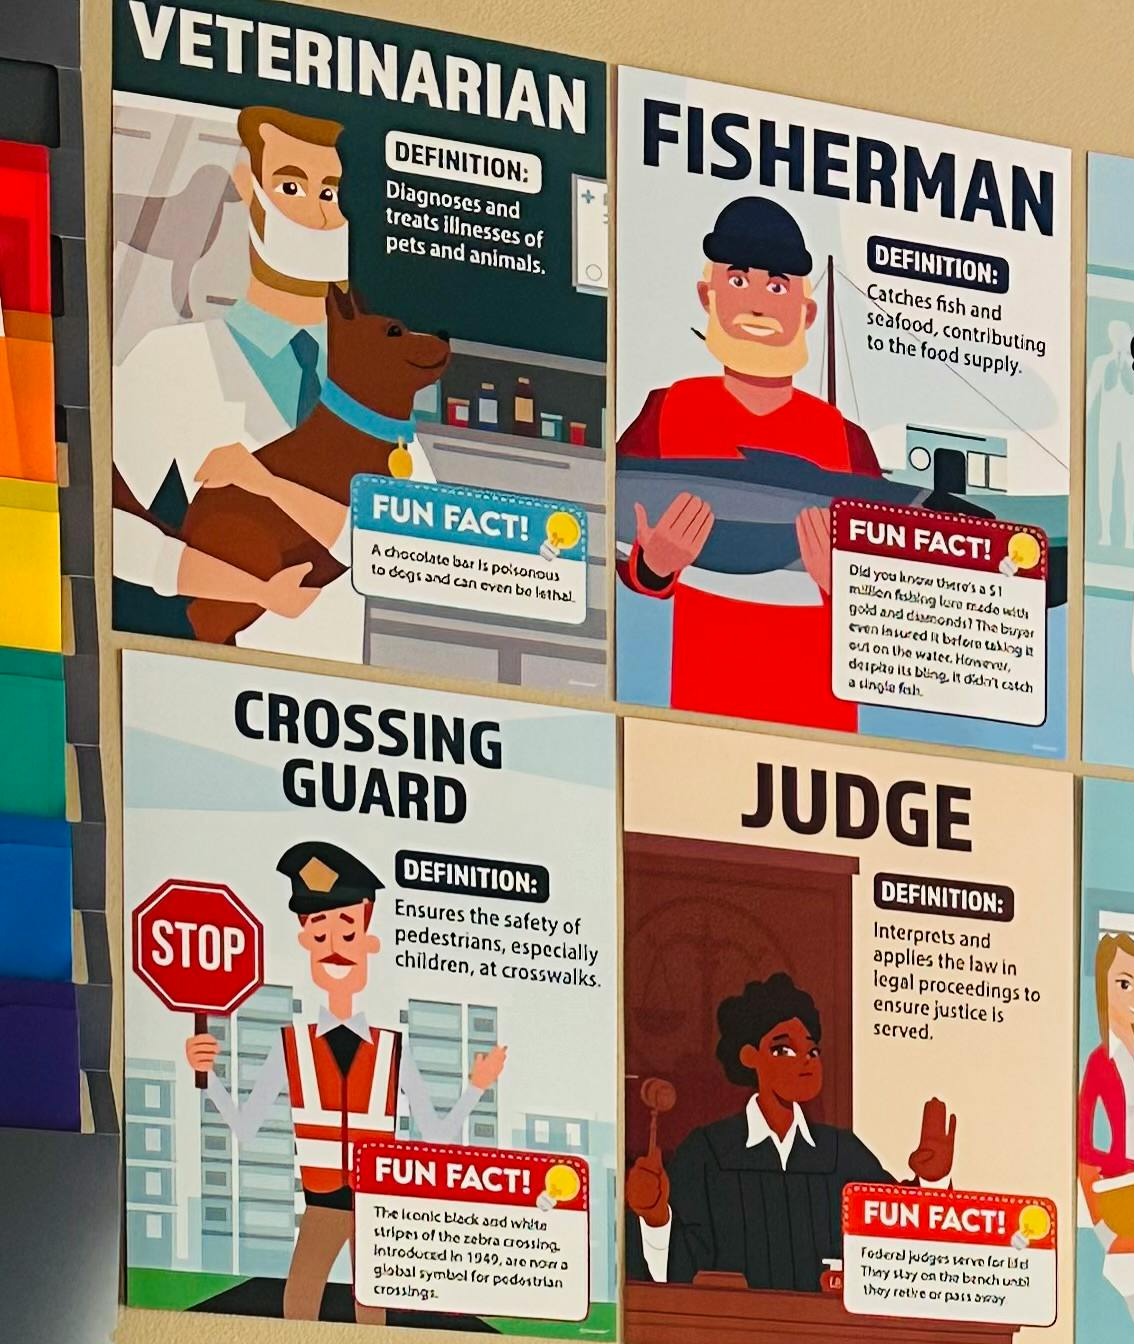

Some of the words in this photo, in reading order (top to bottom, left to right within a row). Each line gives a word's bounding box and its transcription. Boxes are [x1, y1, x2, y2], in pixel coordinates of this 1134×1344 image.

[128, 0, 585, 134] VETERINARIAN
[395, 140, 528, 183] DEFINITION:
[643, 97, 1053, 236] FISHERMAN
[386, 179, 481, 212] Diagnoses
[485, 200, 519, 219] and
[385, 207, 439, 231] treats
[443, 215, 520, 244] illnesses
[524, 229, 543, 248] of
[386, 236, 426, 254] pets
[429, 242, 464, 261] and
[469, 248, 545, 274] animals.
[875, 245, 997, 284] DEFINITION:
[867, 283, 931, 309] Catches
[936, 294, 965, 315] fish
[970, 304, 1001, 321] and
[867, 334, 883, 350] to
[888, 336, 916, 356] the
[920, 341, 958, 366] food
[964, 353, 1021, 376] supply.
[373, 493, 433, 527] FUN
[444, 503, 528, 541] FACT!
[371, 543, 381, 556] A
[384, 545, 449, 566] chocolate
[452, 554, 474, 568] bar
[849, 518, 905, 548] FUN
[914, 528, 990, 560] FACT!
[234, 690, 502, 769] CROSSING
[282, 758, 466, 824] GUARD
[741, 761, 972, 852] JUDGE
[403, 858, 537, 893] DEFINITION:
[881, 880, 1003, 914] DEFINITION:
[395, 898, 464, 922] Ensures
[469, 906, 499, 926] the
[504, 911, 558, 936] safety
[563, 917, 581, 935] of
[151, 919, 245, 972] STOP
[395, 926, 505, 954] pedestrians,
[511, 940, 598, 966] especially
[873, 947, 933, 968] applies
[938, 952, 964, 970] the
[969, 954, 998, 973] law
[1002, 959, 1016, 976] in
[395, 950, 474, 976] children,
[479, 961, 497, 977] at
[501, 965, 600, 987] crosswalks.
[874, 969, 913, 992] legal
[919, 979, 1019, 1003] proceedings
[1024, 987, 1040, 1002] to
[873, 1023, 933, 1040] served.
[375, 1156, 436, 1186] FUN
[446, 1162, 530, 1194] FACT!
[864, 1200, 919, 1228] FUN
[929, 1205, 1005, 1234] FACT!
[373, 1263, 415, 1278] global
[419, 1268, 467, 1282] symbol
[471, 1269, 489, 1283] for
